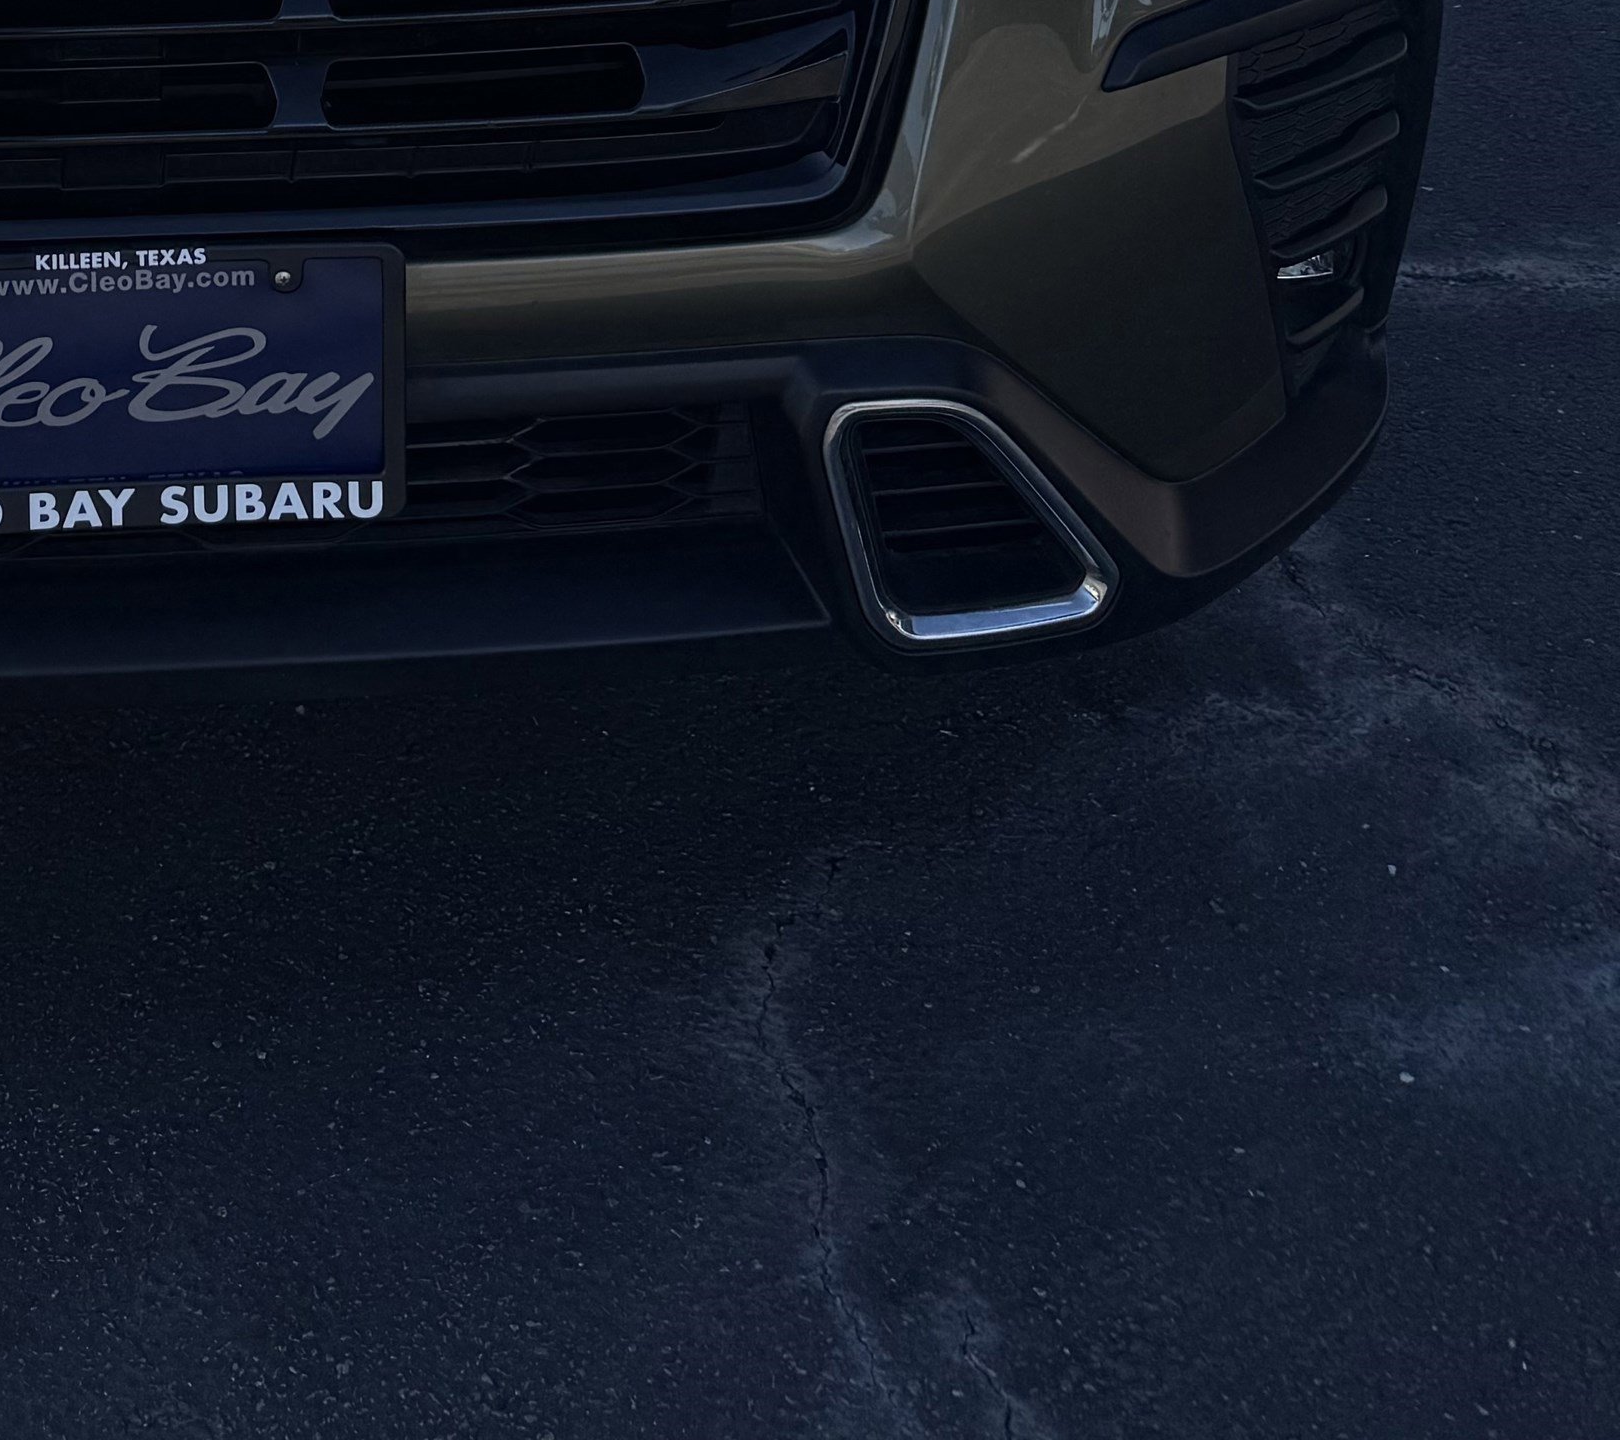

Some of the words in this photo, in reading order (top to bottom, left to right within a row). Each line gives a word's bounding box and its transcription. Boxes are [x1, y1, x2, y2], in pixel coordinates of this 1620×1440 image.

[35, 251, 128, 270] KILLEEN,
[136, 248, 207, 266] TEXAS
[128, 324, 374, 440] Bay
[29, 488, 135, 530] BAY
[160, 480, 384, 524] SUBARU
